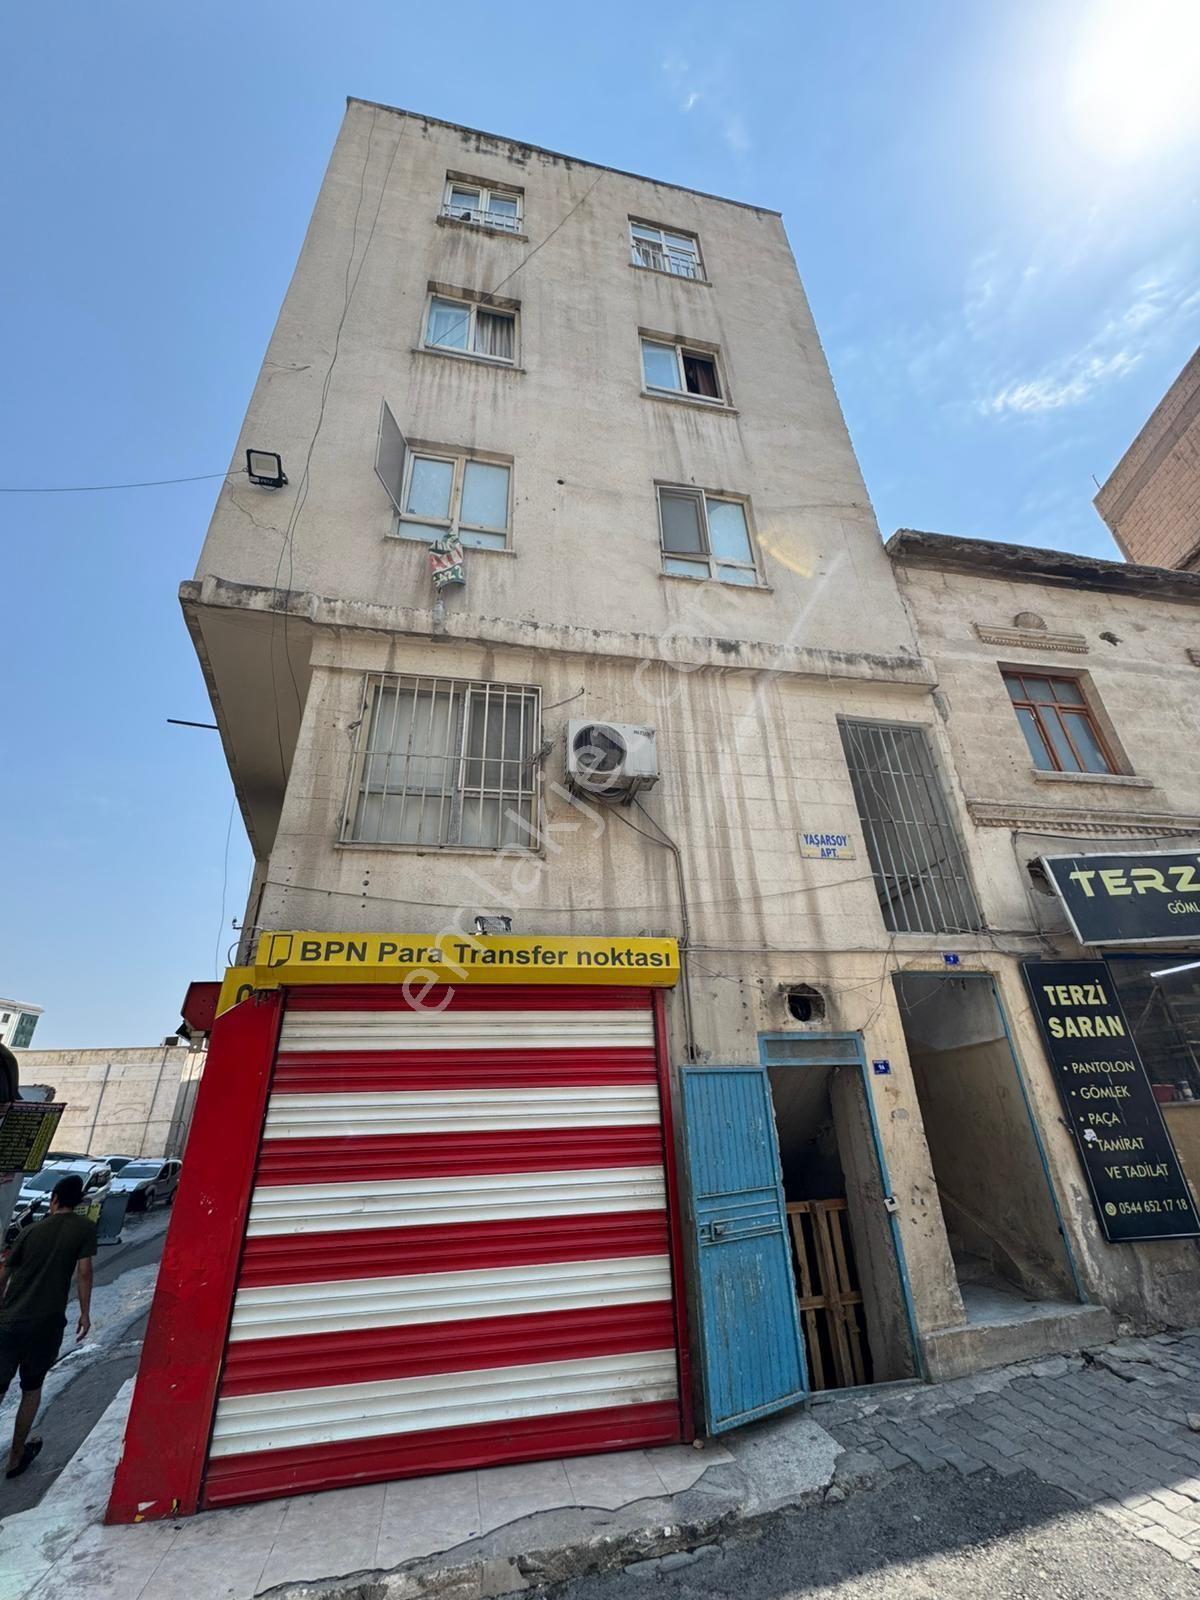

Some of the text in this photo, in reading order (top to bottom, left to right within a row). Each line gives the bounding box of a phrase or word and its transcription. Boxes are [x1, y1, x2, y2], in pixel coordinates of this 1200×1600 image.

[803, 833, 847, 847] YAŞARSOY
[821, 847, 839, 858] APT.
[1069, 857, 1200, 897] TERZ
[300, 941, 670, 966] BPN Para Transfer noktası
[1043, 979, 1108, 1006] TERZİ
[1048, 1015, 1125, 1038] SARAN
[1071, 1060, 1136, 1074] PANTOLON
[1080, 1085, 1131, 1099] GÖMLEK
[1088, 1112, 1121, 1127] PAÇA
[1096, 1136, 1145, 1151] TAMİRAT
[1104, 1161, 1169, 1179] VE TADİLAT
[1118, 1198, 1188, 1214] 0544 652 17 18
